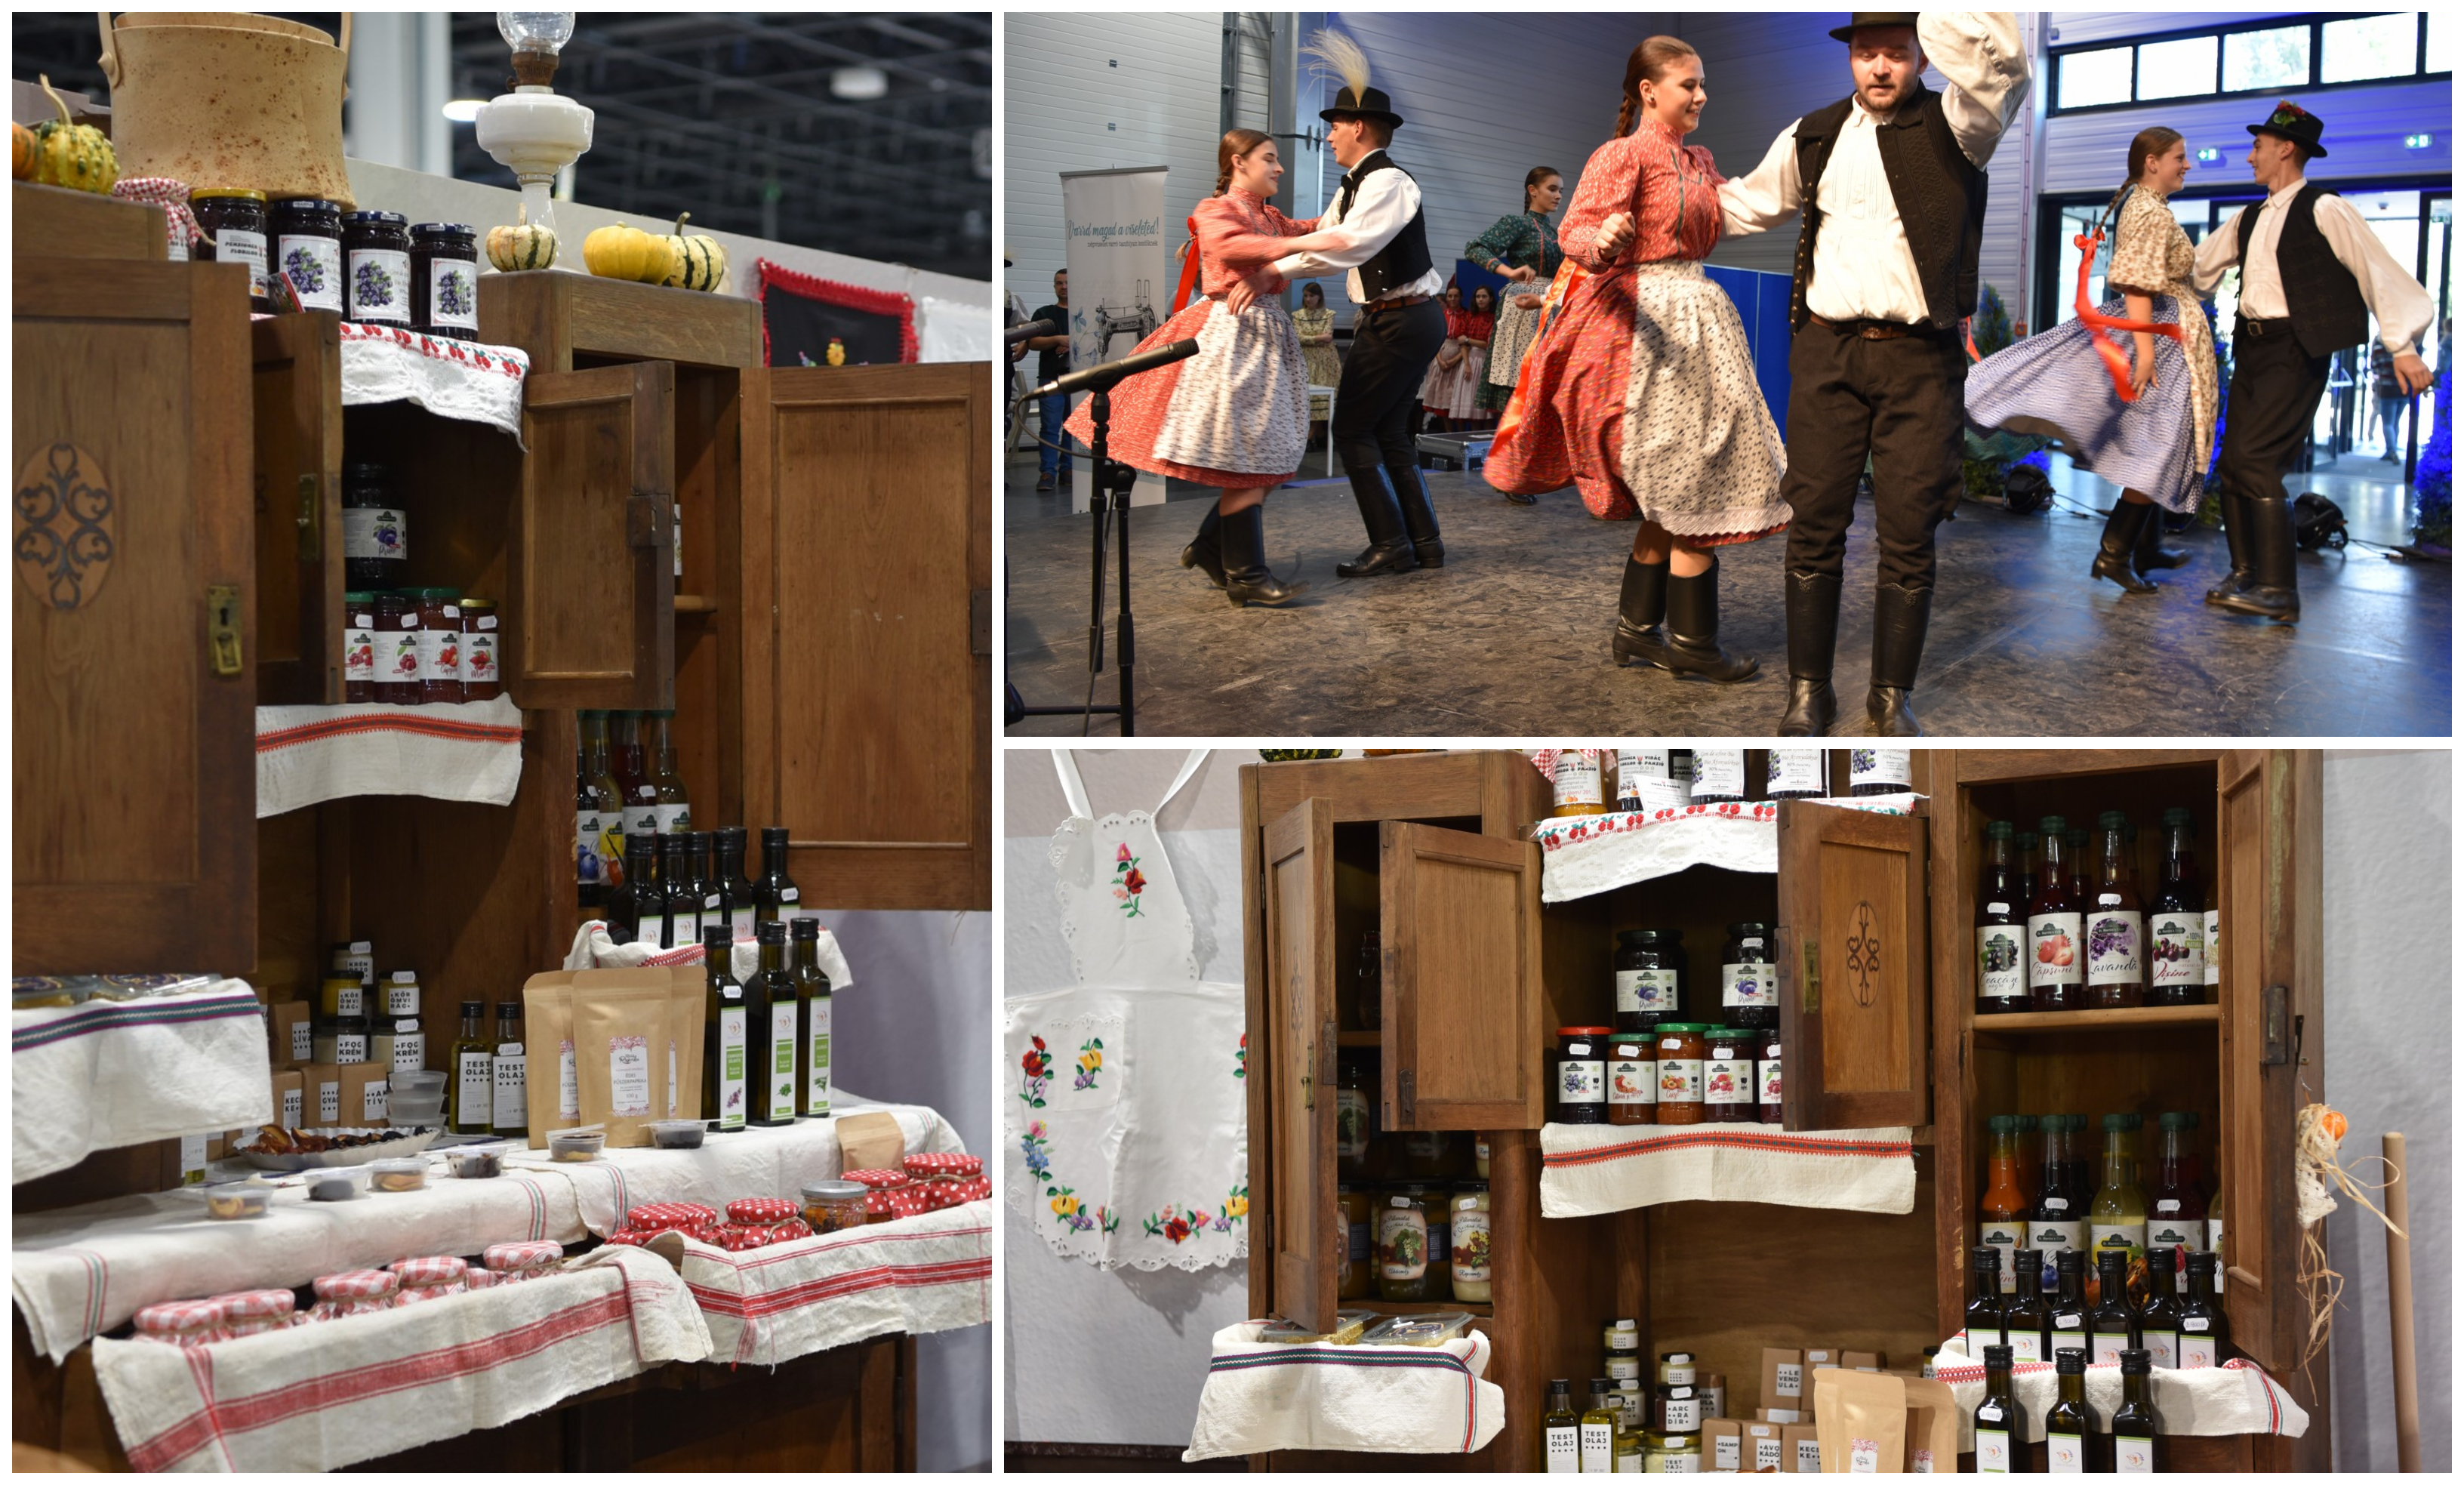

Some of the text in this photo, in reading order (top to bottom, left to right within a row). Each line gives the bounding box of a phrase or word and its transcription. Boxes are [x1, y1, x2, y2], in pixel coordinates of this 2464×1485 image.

[1092, 222, 1118, 242] magad
[1118, 226, 1123, 236] a
[338, 1047, 362, 1056] KRÉM
[396, 1048, 419, 1057] KRÉM
